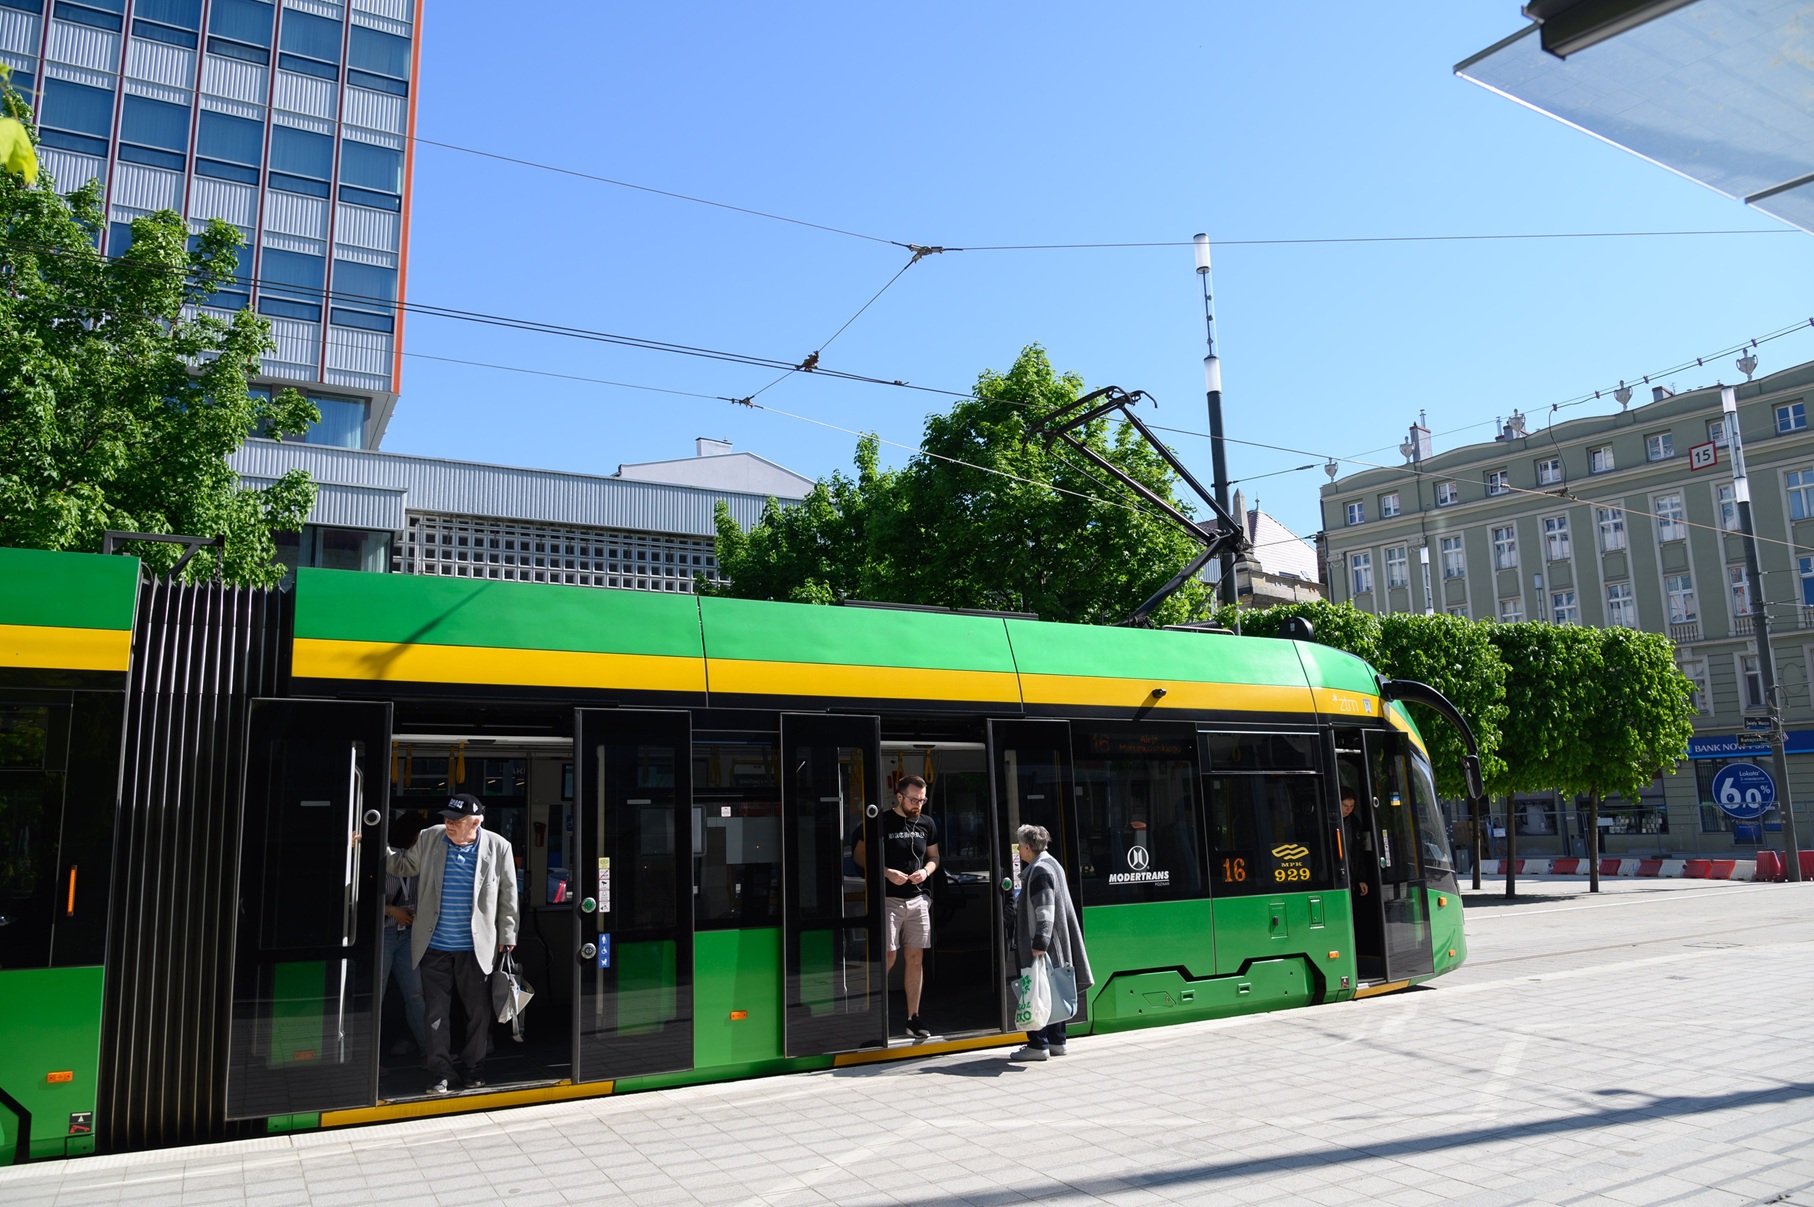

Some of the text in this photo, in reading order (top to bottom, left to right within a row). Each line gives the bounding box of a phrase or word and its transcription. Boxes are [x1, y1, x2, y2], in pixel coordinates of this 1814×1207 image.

[1695, 448, 1711, 463] 15
[1338, 697, 1360, 713] ztm
[1694, 744, 1721, 752] BANK
[1108, 870, 1170, 883] MODERTRANS
[1222, 857, 1246, 882] 16
[1274, 867, 1311, 882] 929
